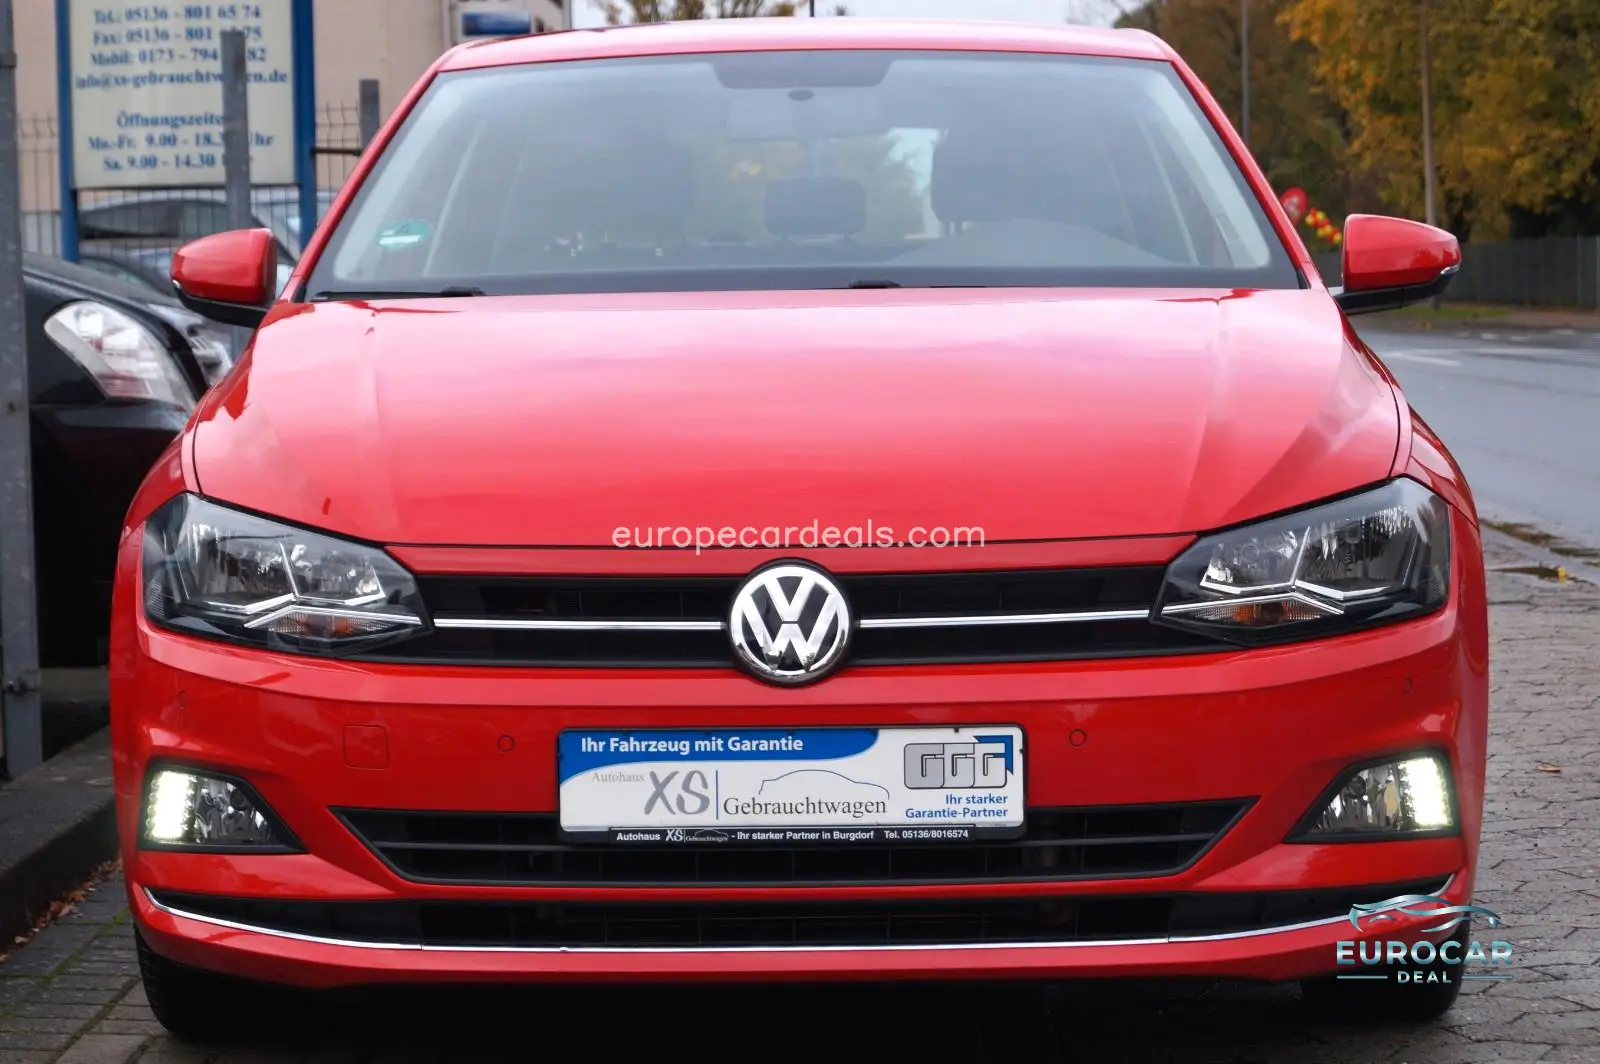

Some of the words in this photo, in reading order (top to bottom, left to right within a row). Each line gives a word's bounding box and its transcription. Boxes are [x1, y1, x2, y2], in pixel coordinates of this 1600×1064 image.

[125, 6, 169, 20] 05136
[184, 5, 211, 19] 801
[218, 5, 236, 18] 65
[242, 5, 261, 18] 74
[93, 30, 122, 46] Fax:
[126, 28, 169, 42] 05136
[185, 27, 212, 41] 801
[243, 26, 262, 40] 75
[90, 50, 133, 66] Mobil:
[138, 48, 174, 63] 0173
[190, 48, 218, 61] 794
[246, 47, 266, 61] 82
[76, 69, 287, 91] info@xs-gebrauchtwen.de
[117, 109, 223, 129] Öffnungszeite
[145, 132, 177, 147] 9.00
[249, 131, 274, 146] hr
[127, 154, 157, 168] 9.00
[175, 152, 215, 168] 14.30
[581, 737, 606, 753] Ihr
[609, 737, 690, 756] Fahrzeug
[694, 736, 724, 752] mit
[727, 736, 804, 751] Garantie
[592, 771, 645, 783] Autohaus
[644, 769, 710, 816] XS
[945, 794, 962, 805] Ihr
[965, 793, 1008, 804] starker
[723, 796, 886, 818] Gebrauchtwagen
[905, 807, 1008, 819] Garantie-Partner
[616, 832, 661, 841] Autohaus
[665, 829, 683, 842] XS
[737, 831, 750, 840] Ihr
[752, 831, 784, 840] starker
[786, 831, 820, 840] Partner
[822, 830, 831, 839] in
[833, 830, 874, 841] Burgdorf
[884, 830, 900, 839] Tel.
[902, 829, 969, 839] 05136/8016574
